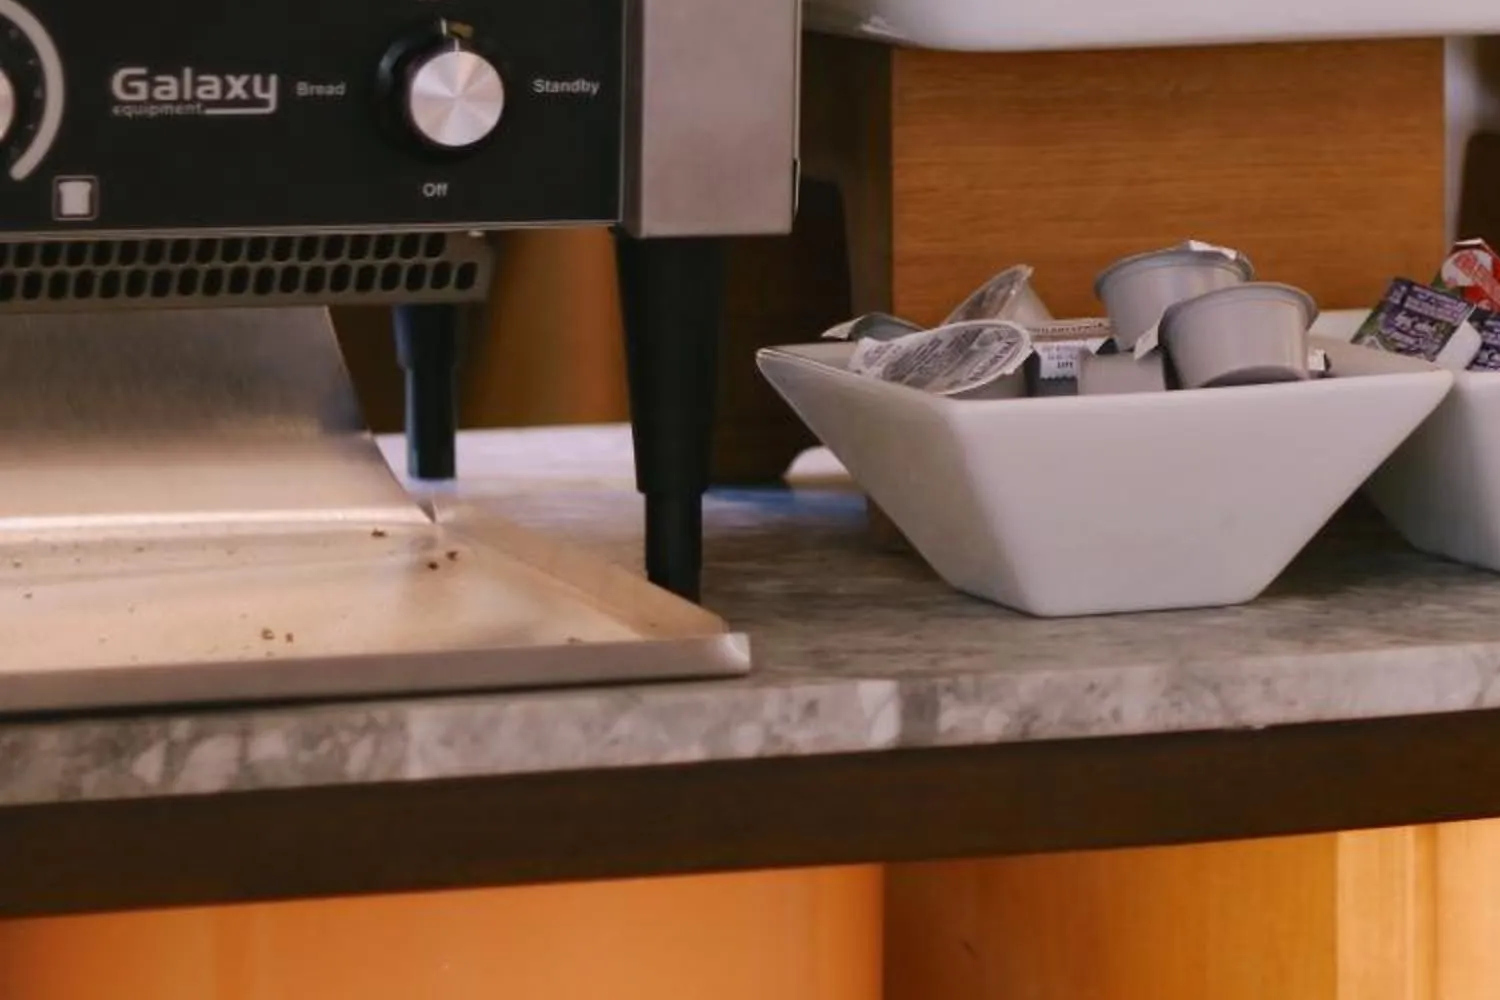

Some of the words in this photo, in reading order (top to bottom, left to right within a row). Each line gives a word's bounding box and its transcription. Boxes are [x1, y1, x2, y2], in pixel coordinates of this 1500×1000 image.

[111, 66, 278, 117] Galaxy
[296, 81, 345, 96] Bread
[532, 78, 600, 96] Standby
[111, 102, 202, 118] equipment
[422, 182, 448, 198] Off
